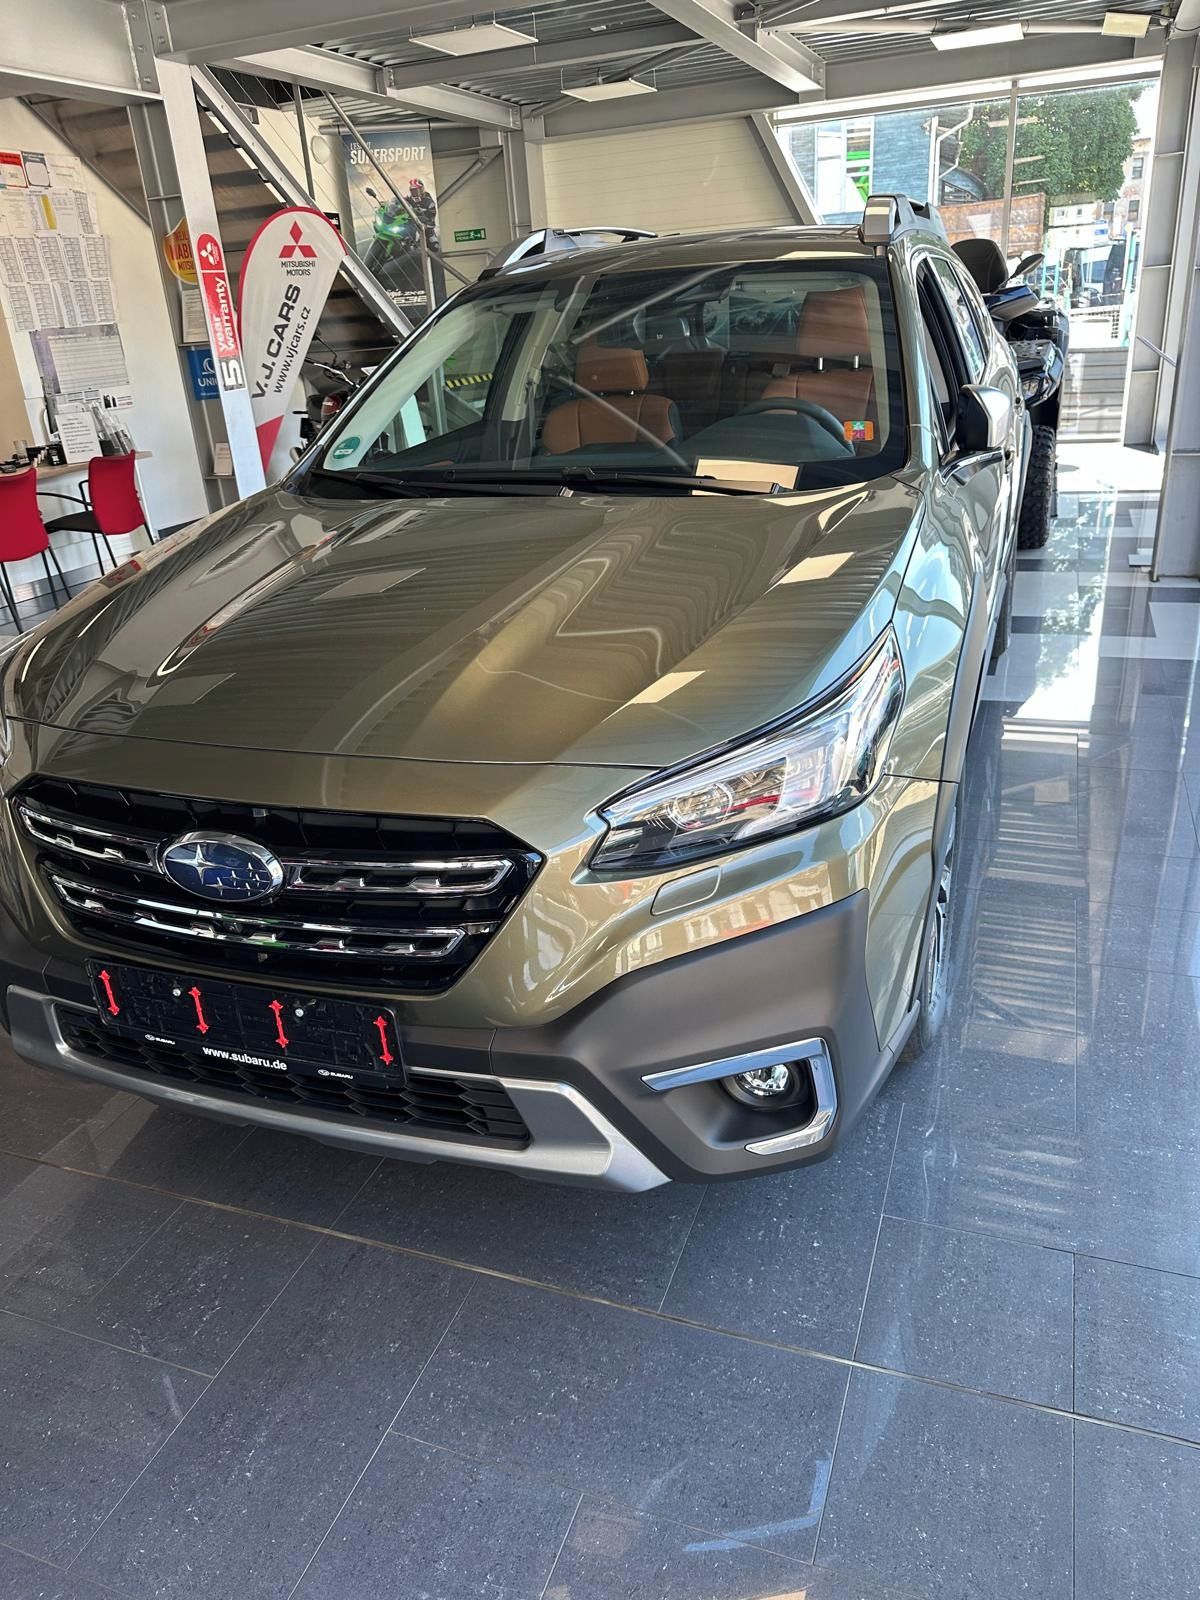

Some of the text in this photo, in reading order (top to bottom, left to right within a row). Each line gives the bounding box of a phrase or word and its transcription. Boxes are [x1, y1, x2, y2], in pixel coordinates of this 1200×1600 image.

[281, 260, 316, 268] MITSUBISHI
[213, 313, 243, 386] 5 year
[214, 276, 236, 351] warranty
[274, 306, 311, 393] www.vjcars.cz
[202, 1047, 288, 1071] www.subaru.de
